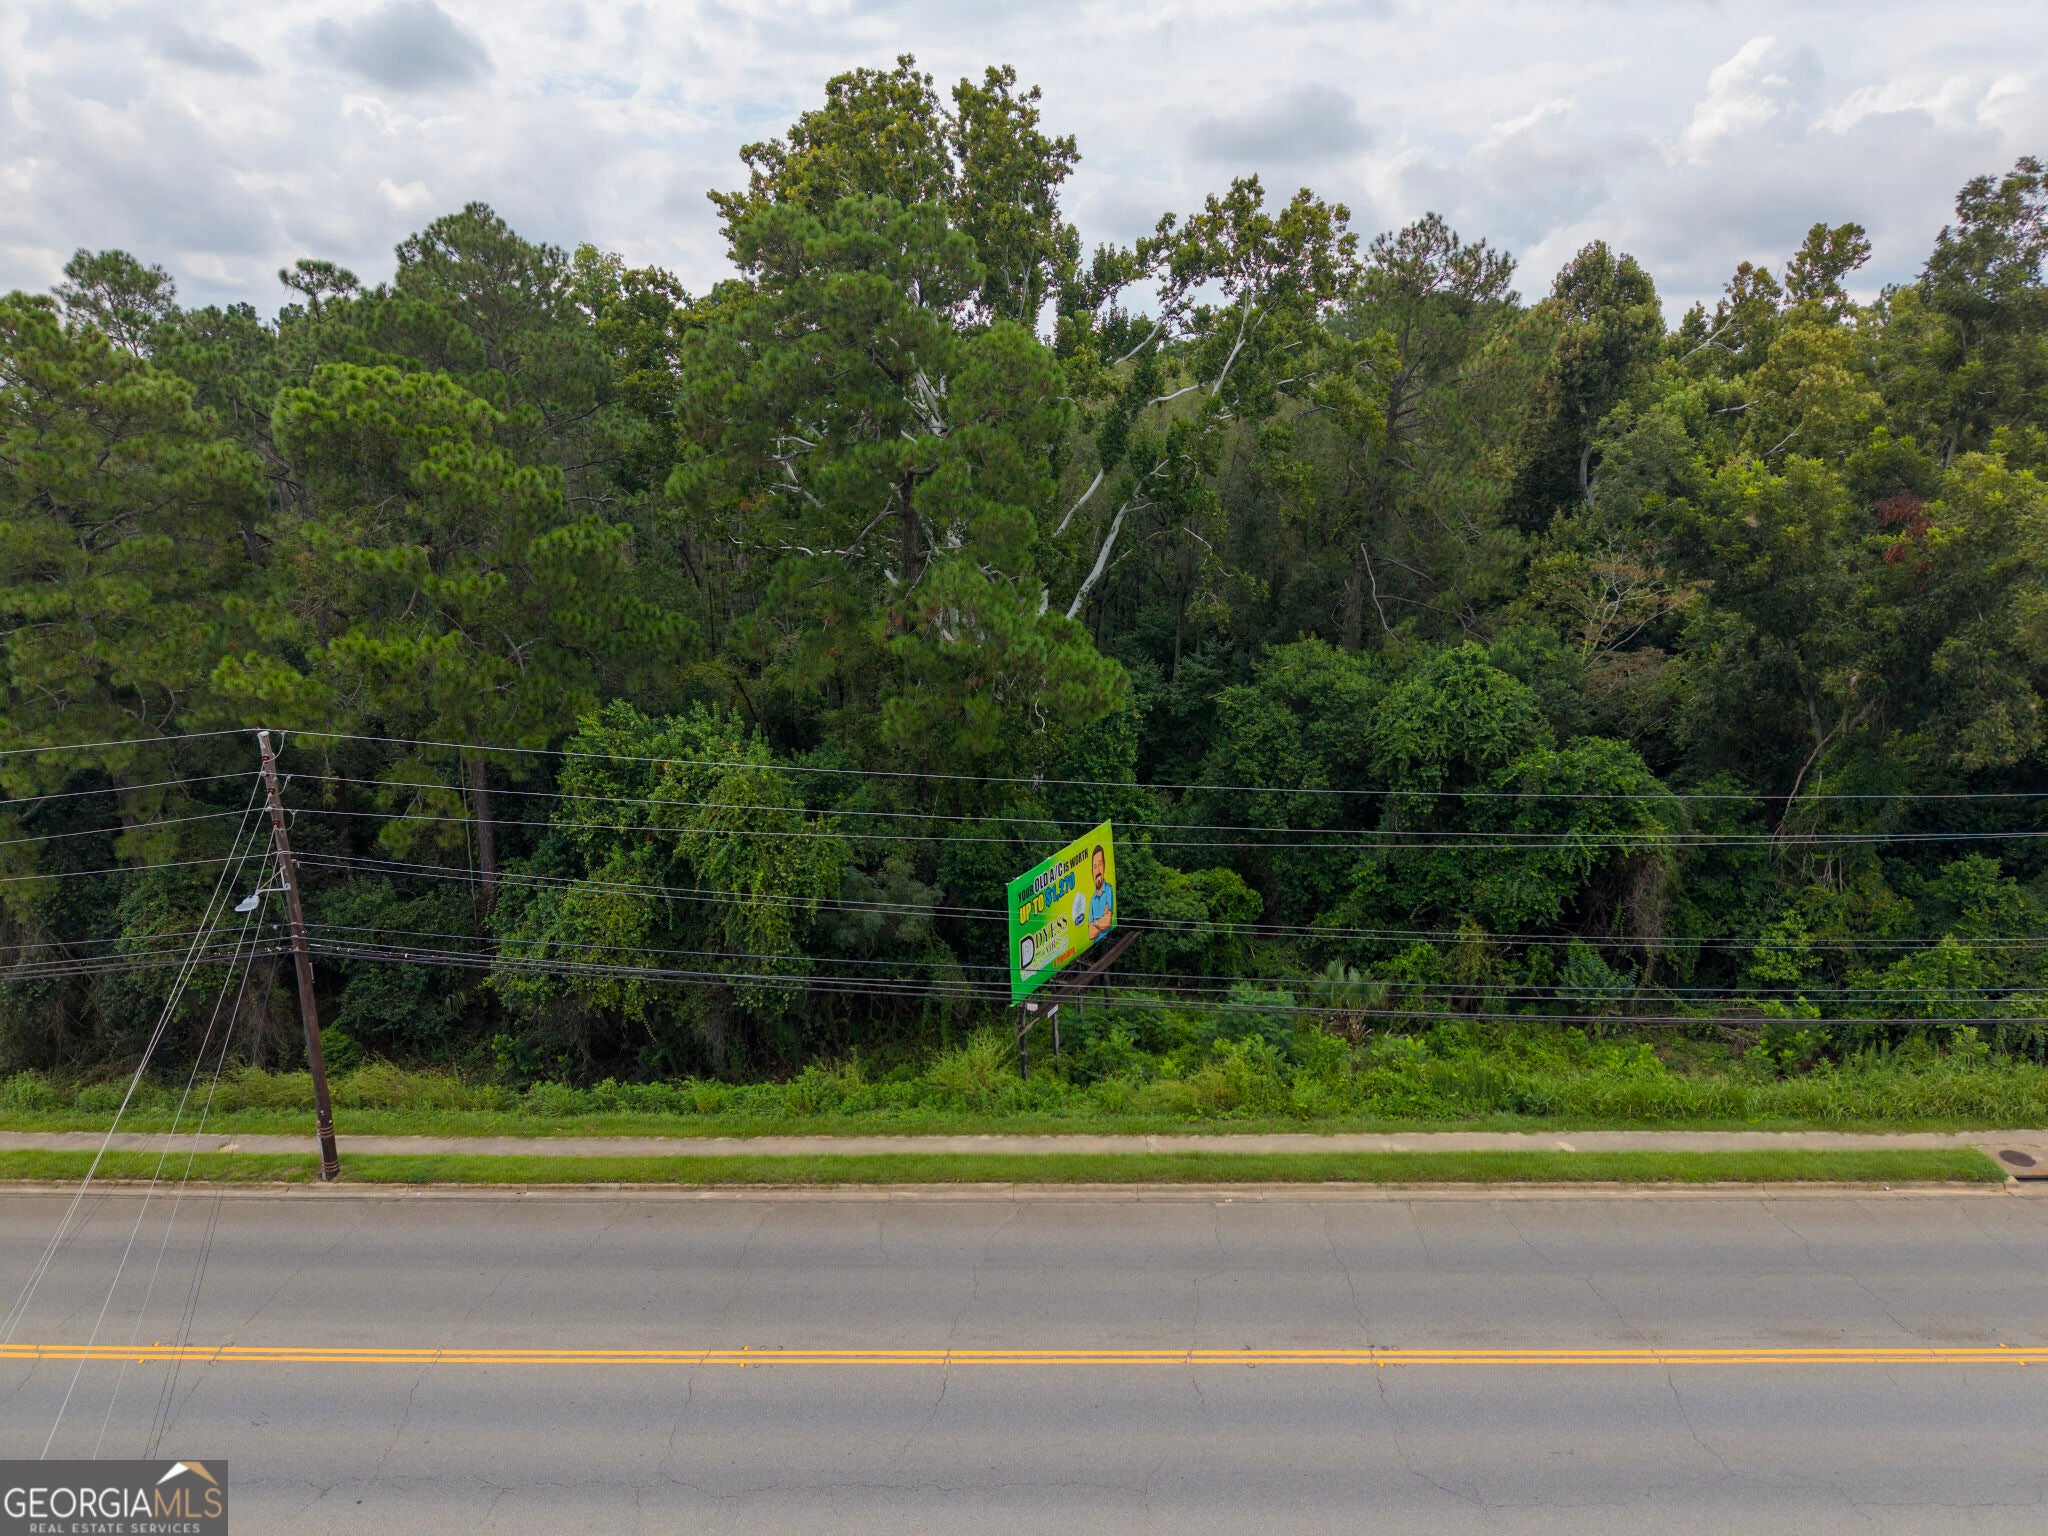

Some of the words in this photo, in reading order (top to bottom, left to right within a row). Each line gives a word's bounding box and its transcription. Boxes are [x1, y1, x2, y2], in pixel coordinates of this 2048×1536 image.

[1018, 885, 1034, 903] YOUR
[1034, 872, 1048, 892] OLD
[1050, 862, 1063, 882] A/C
[1064, 861, 1069, 873] IS
[1070, 848, 1088, 869] WORTH
[1019, 902, 1031, 925] UP
[1033, 893, 1044, 916] TO
[1045, 871, 1075, 908] $1,270
[1035, 914, 1068, 949] DYESS
